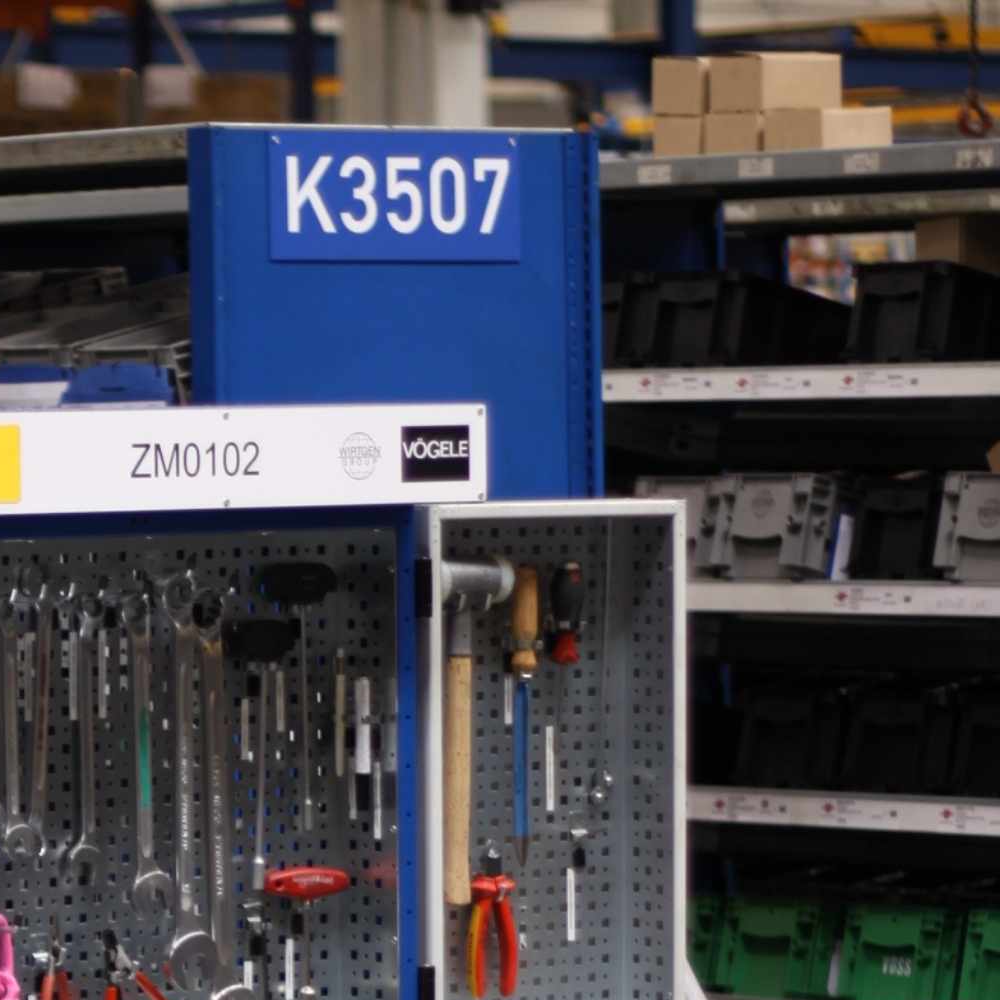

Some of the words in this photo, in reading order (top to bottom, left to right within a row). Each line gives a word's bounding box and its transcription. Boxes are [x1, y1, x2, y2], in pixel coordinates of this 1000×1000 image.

[285, 155, 510, 234] K3507
[130, 441, 261, 479] ZM0102
[402, 438, 469, 459] VÖGELE
